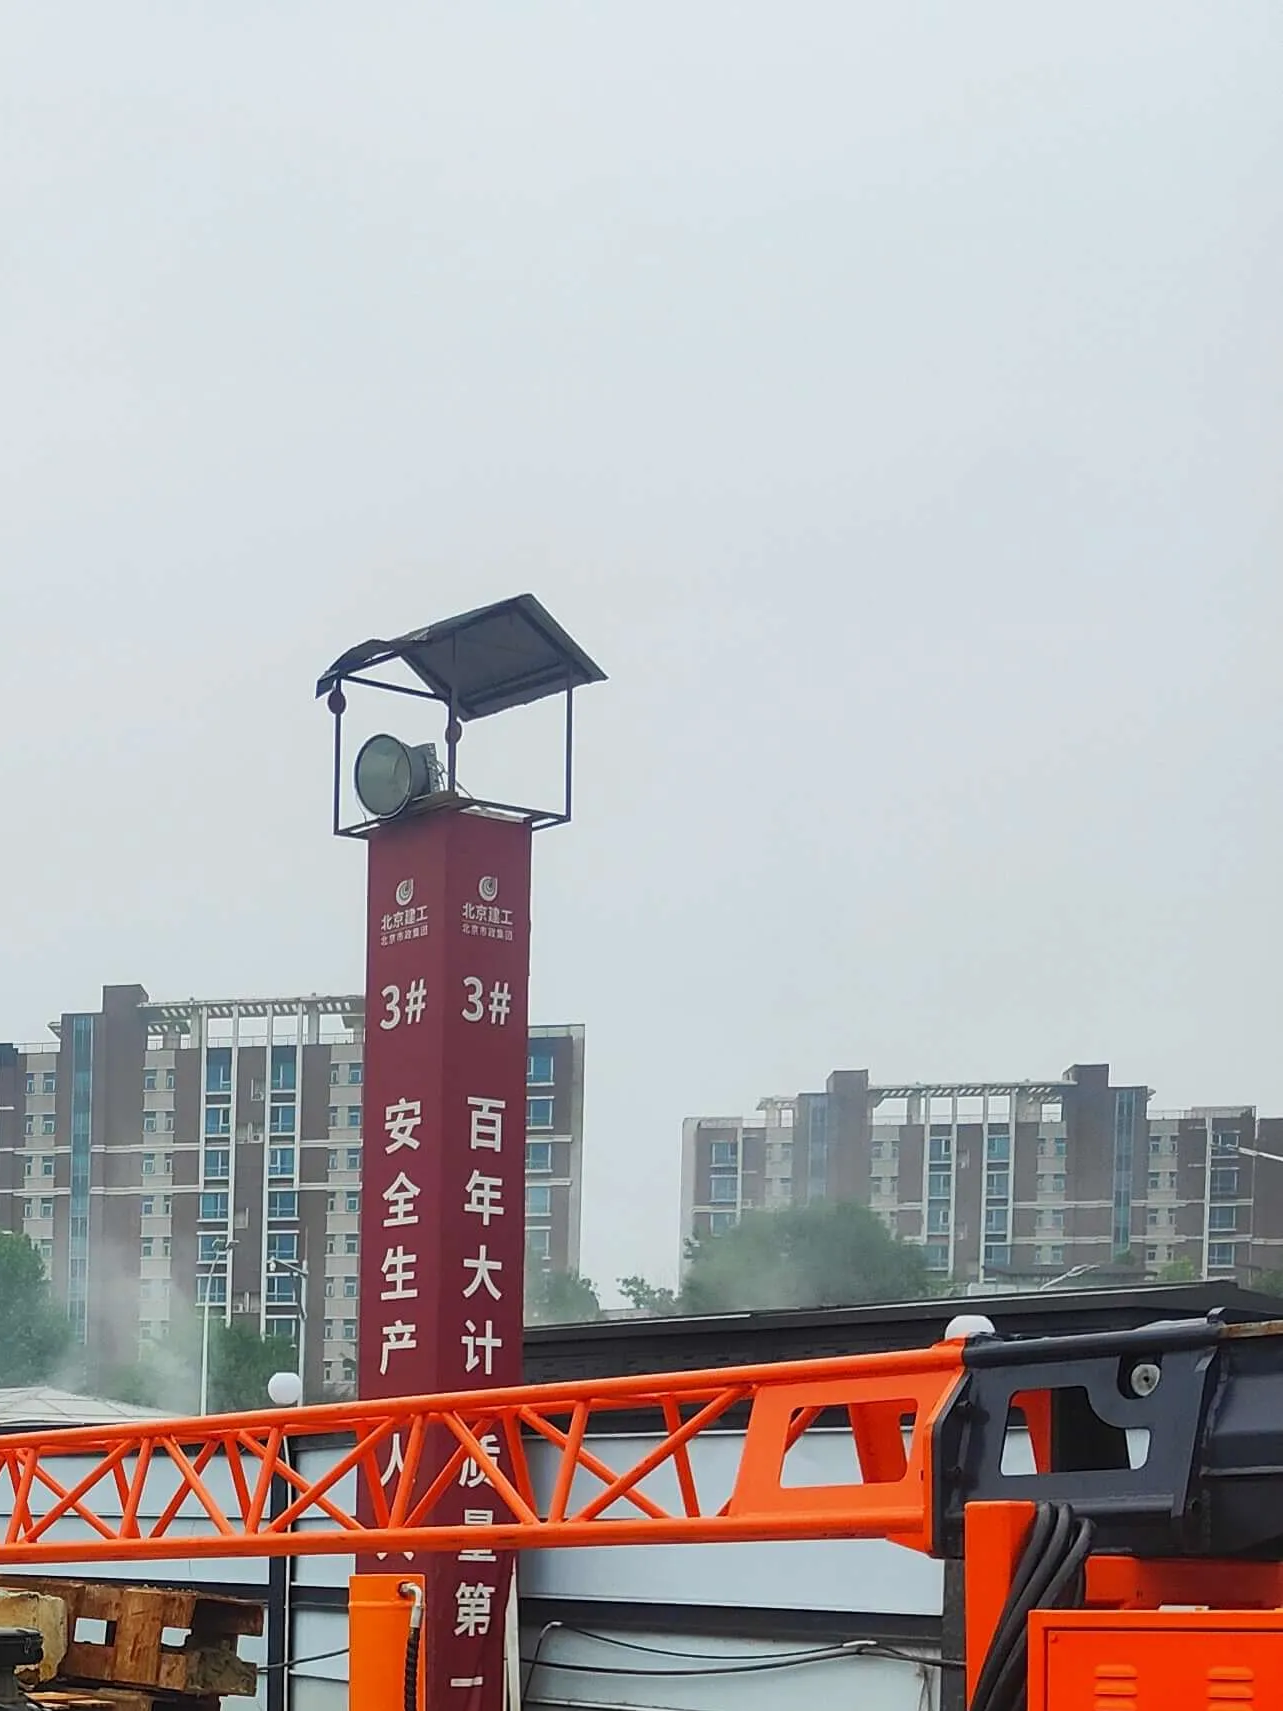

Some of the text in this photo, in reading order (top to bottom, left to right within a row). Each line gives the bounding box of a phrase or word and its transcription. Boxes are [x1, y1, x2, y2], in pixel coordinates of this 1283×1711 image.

[381, 905, 428, 931] 北京建工
[463, 903, 513, 925] 北京建工
[463, 923, 513, 941] 北京市政集团
[381, 925, 428, 946] 北京市政集团
[380, 978, 427, 1030] 3#
[462, 976, 511, 1025] 3#
[379, 1097, 421, 1375] 安全生产
[461, 1096, 506, 1375] 百年大计
